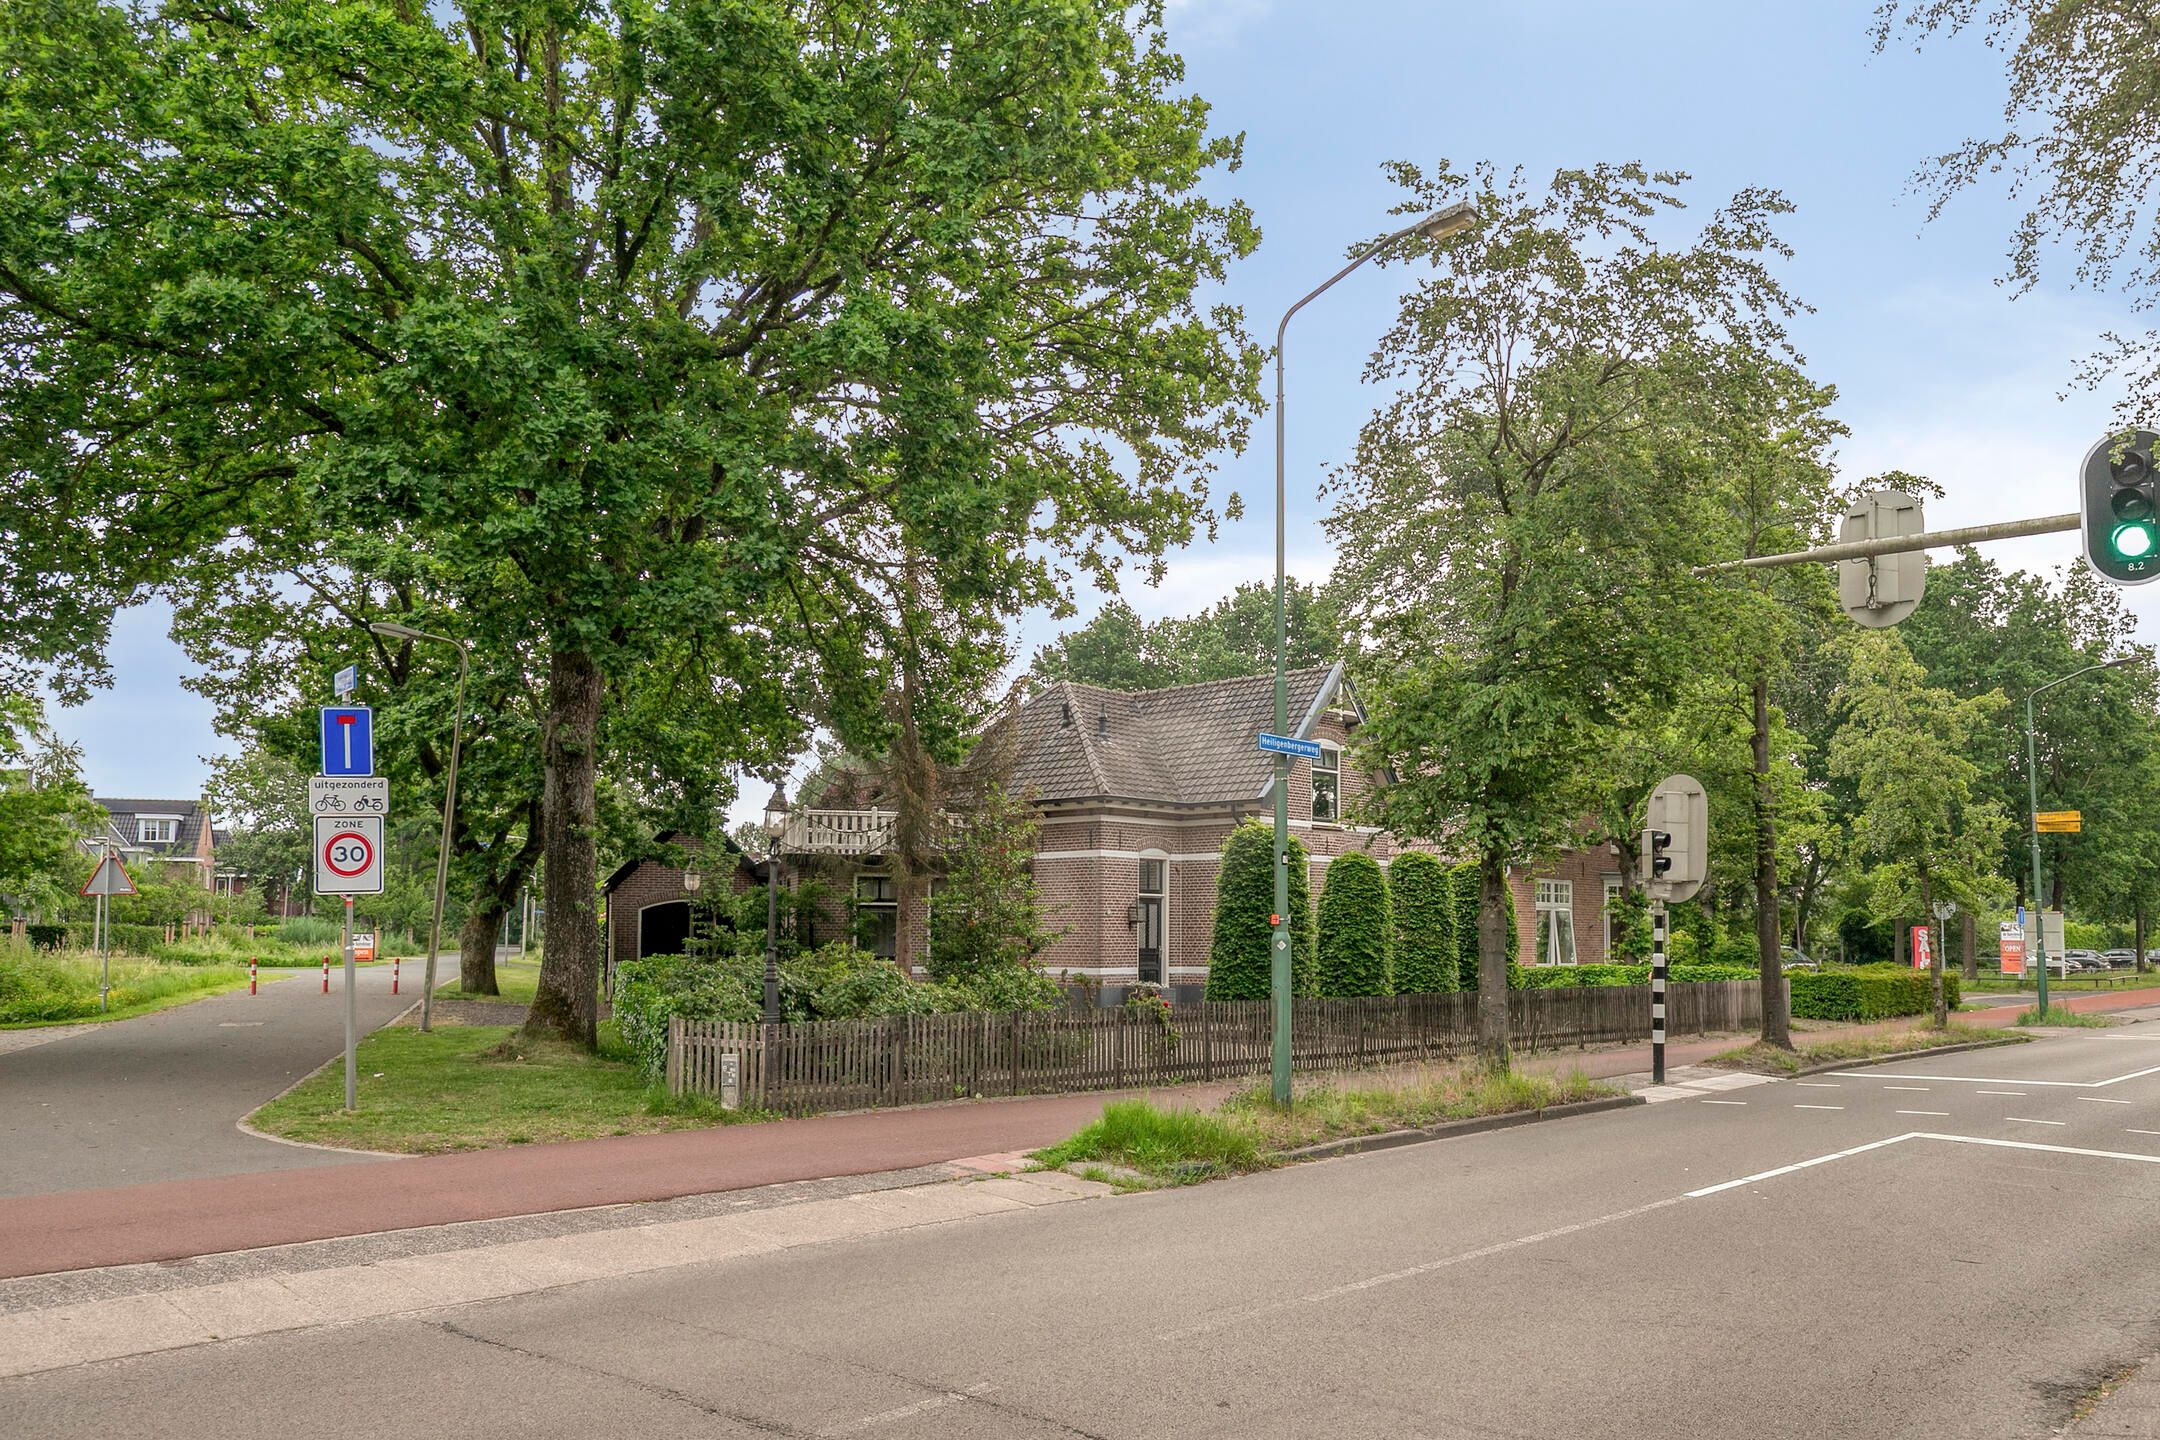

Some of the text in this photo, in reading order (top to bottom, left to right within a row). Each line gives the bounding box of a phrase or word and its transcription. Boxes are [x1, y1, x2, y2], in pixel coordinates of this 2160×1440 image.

[2128, 561, 2145, 571] 8.2
[1261, 736, 1319, 756] Heiligenbergerweg
[314, 781, 384, 791] uitgezonderd
[334, 820, 364, 829] ZONE
[333, 846, 365, 863] 30
